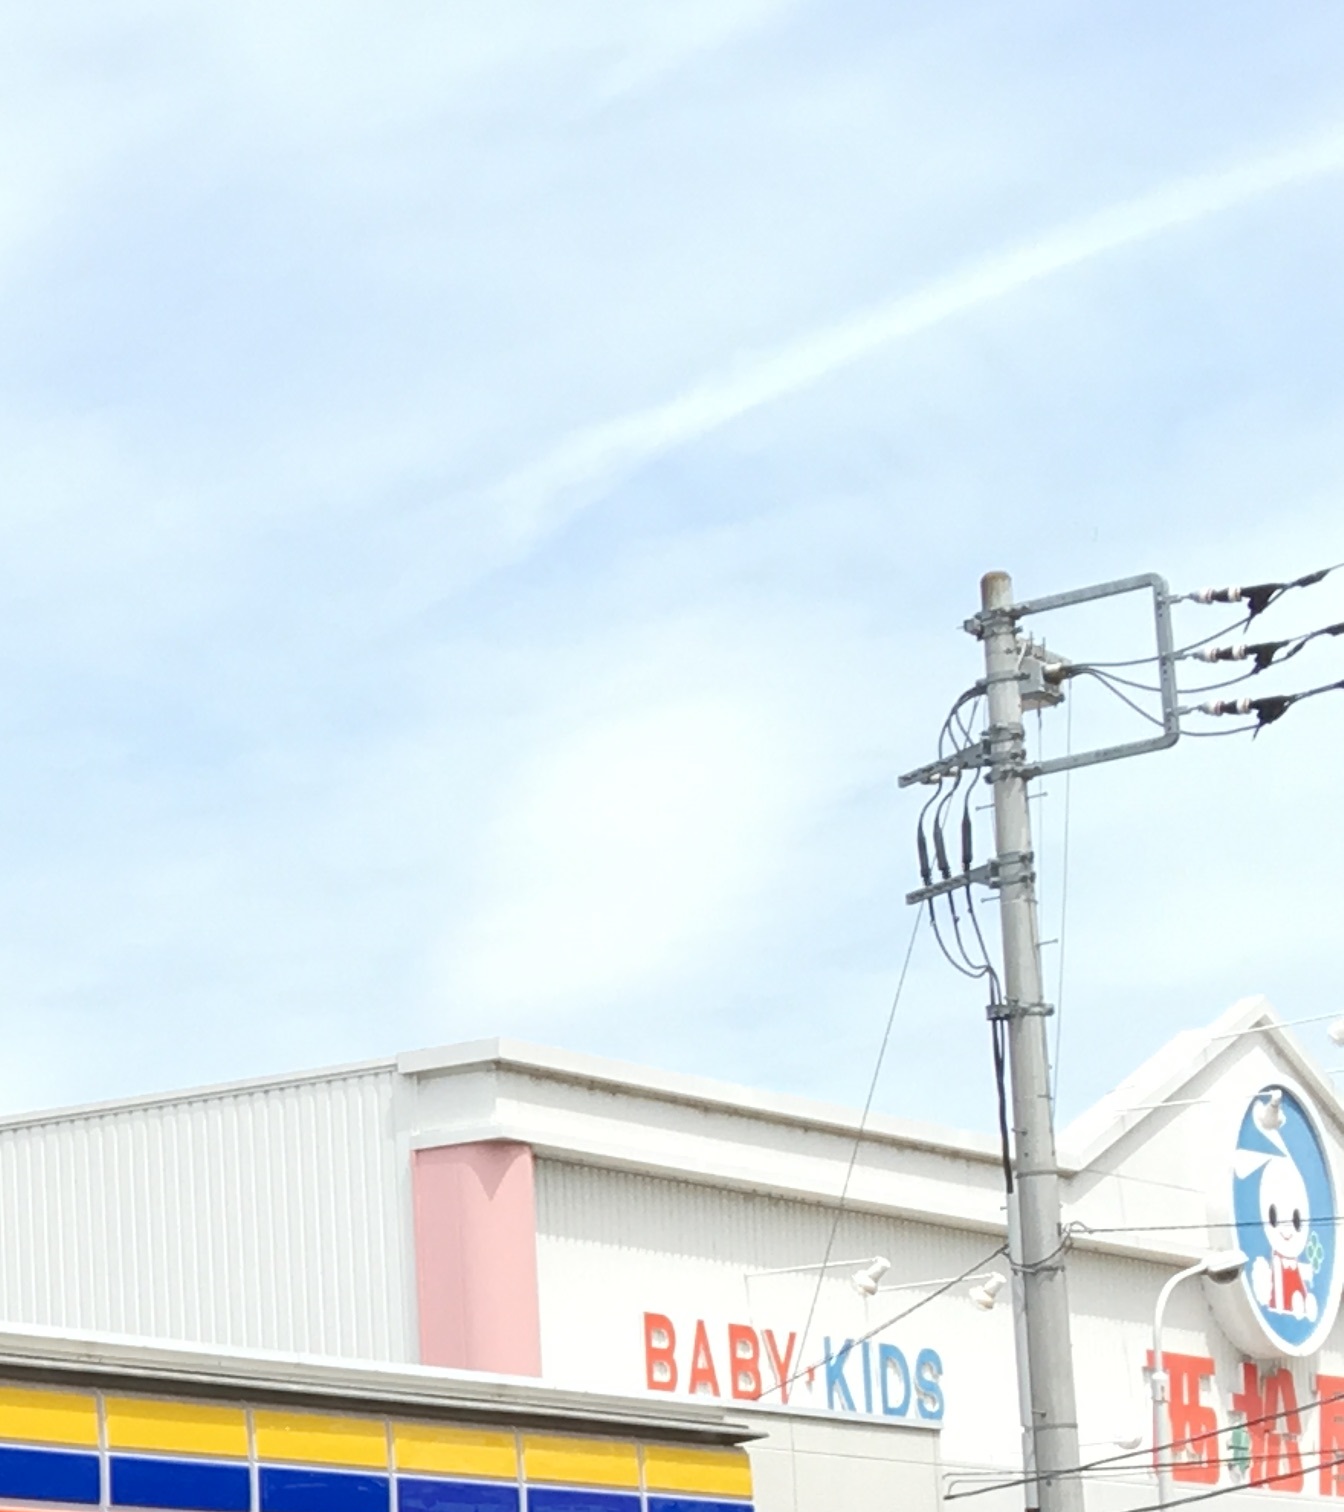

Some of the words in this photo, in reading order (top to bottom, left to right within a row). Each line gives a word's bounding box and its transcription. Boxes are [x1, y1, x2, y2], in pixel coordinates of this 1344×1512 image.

[643, 1311, 797, 1405] BABY
[823, 1336, 945, 1420] KIDS
[1145, 1349, 1344, 1497] 西松
